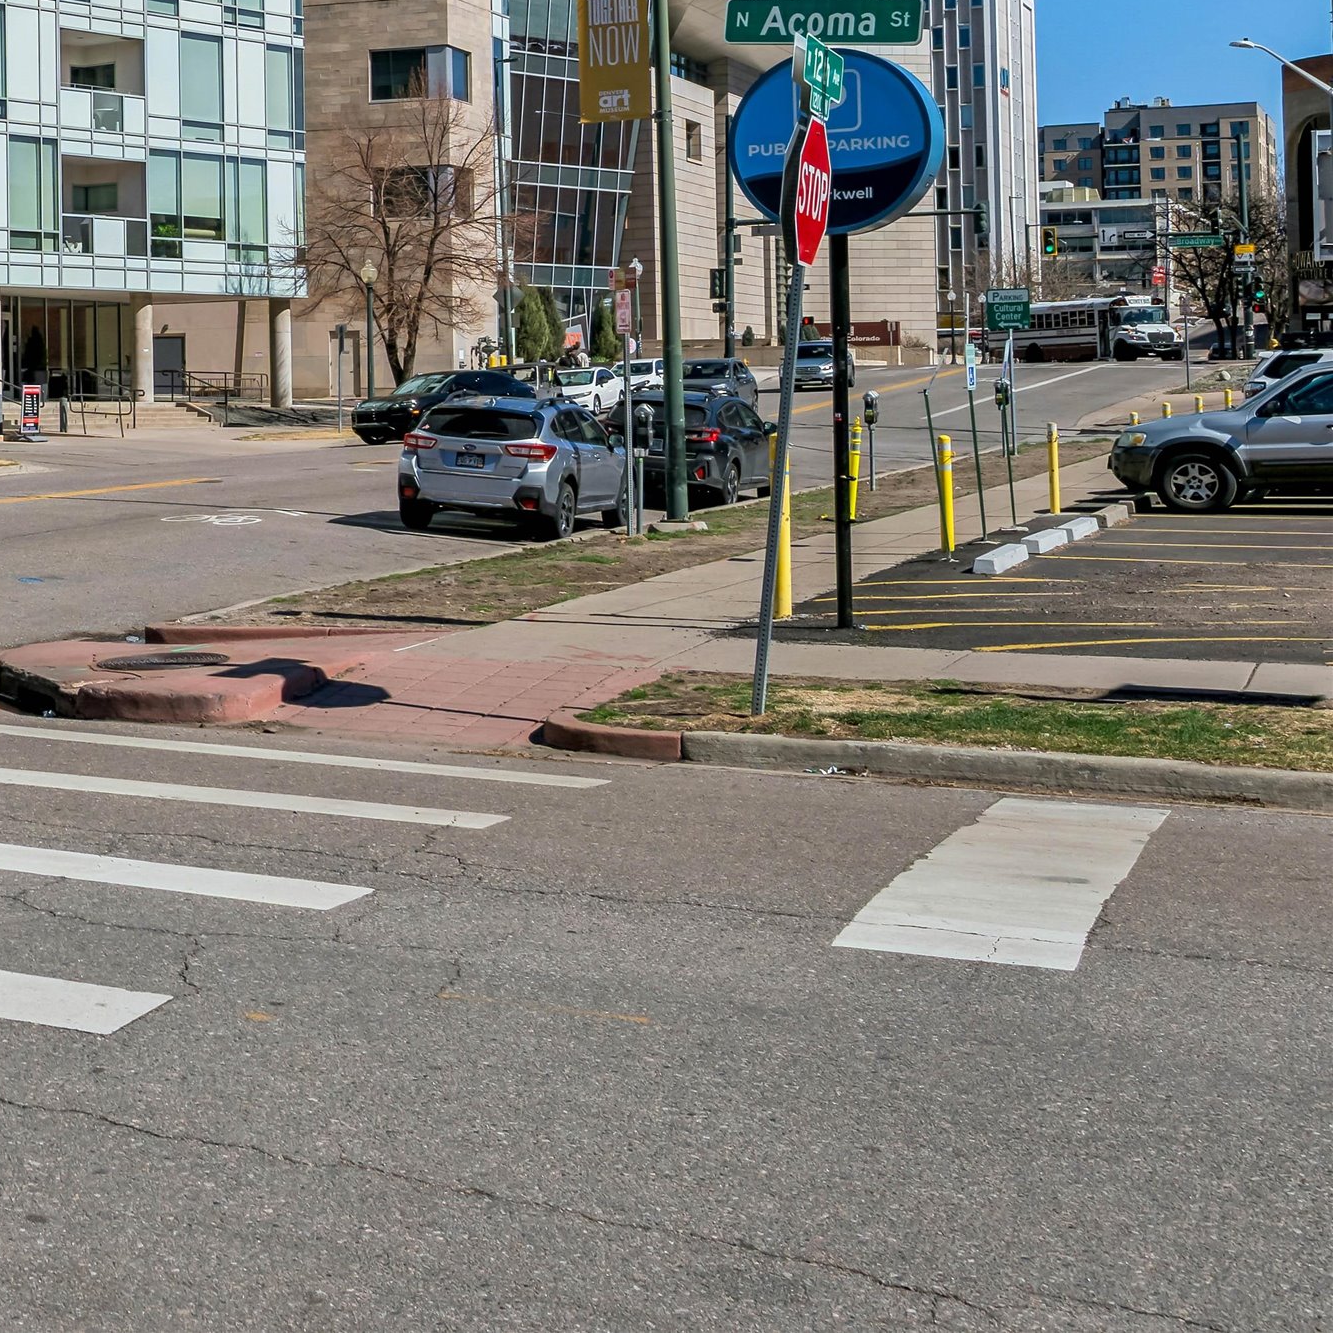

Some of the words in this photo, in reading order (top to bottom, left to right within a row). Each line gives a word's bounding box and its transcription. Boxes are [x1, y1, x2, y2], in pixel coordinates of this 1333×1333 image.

[736, 12, 749, 27] N
[760, 6, 876, 36] Acoma
[890, 11, 910, 27] St
[589, 24, 640, 67] NOW
[598, 89, 631, 108] art
[748, 143, 786, 157] PUB
[798, 161, 828, 223] STOP
[831, 186, 873, 200] kwell
[992, 292, 1024, 302] PARKING
[993, 304, 1024, 312] Cultural
[995, 312, 1022, 321] Center
